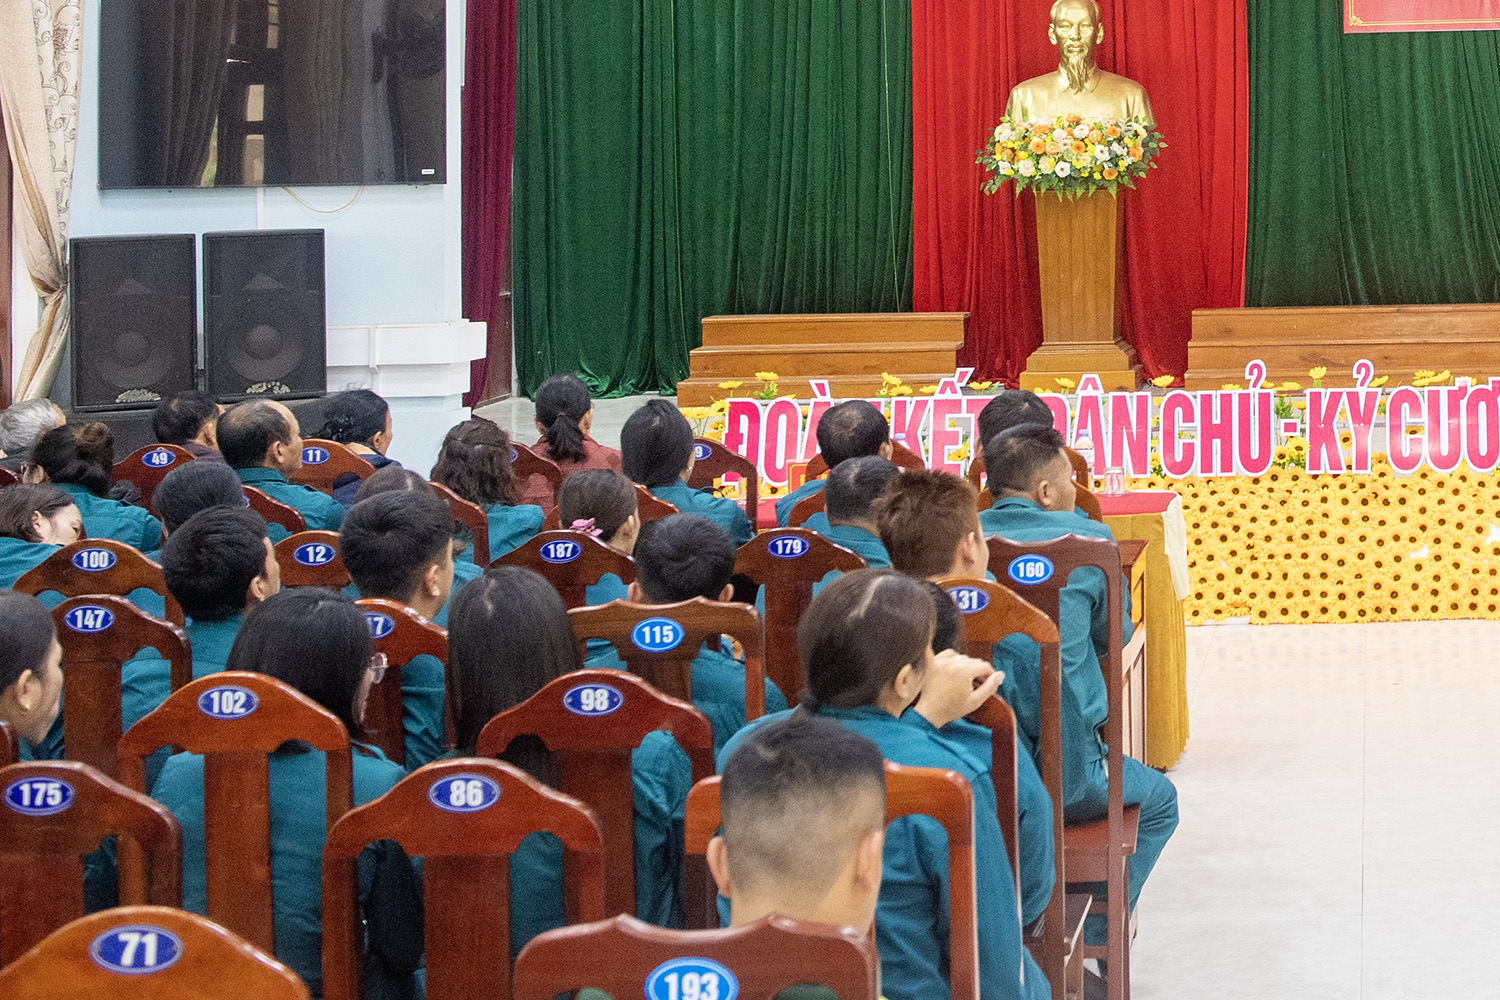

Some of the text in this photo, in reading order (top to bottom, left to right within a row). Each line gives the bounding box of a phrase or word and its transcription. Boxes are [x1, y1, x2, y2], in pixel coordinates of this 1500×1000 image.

[1160, 359, 1274, 478] CHỦ
[1305, 359, 1382, 474] KỶ
[152, 453, 167, 464] 49
[308, 450, 320, 461] 11
[307, 546, 325, 561] 12
[549, 544, 572, 557] 187
[776, 540, 801, 553] 179
[82, 552, 107, 567] 100
[1018, 562, 1044, 577] 160
[76, 610, 104, 628] 147
[643, 626, 673, 643] 115
[211, 692, 245, 713] 102
[581, 689, 607, 710] 98
[21, 784, 60, 805] 175
[451, 781, 482, 806] 86
[119, 933, 156, 965] 71
[665, 973, 718, 1000] 193
